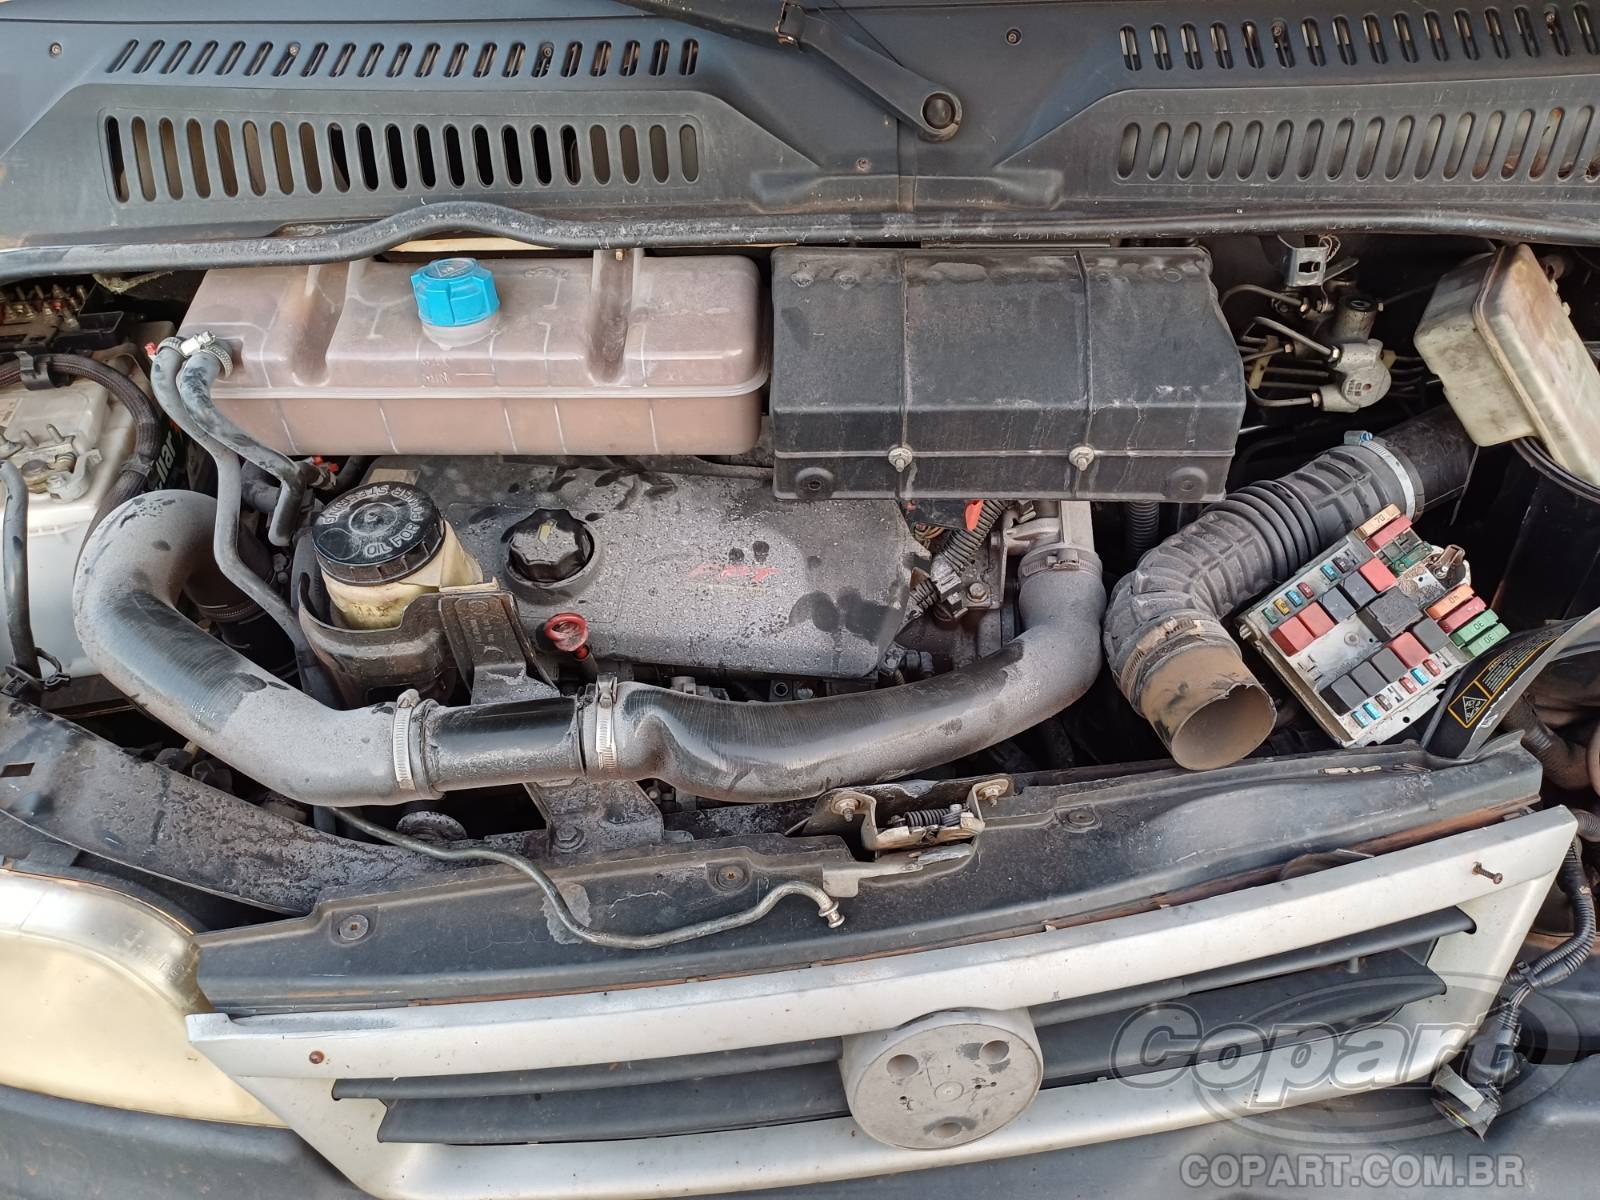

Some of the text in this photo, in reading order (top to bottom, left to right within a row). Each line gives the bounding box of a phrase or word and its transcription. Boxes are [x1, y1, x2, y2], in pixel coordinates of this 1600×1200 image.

[322, 484, 389, 525] STEERING
[390, 522, 420, 548] FOR
[364, 541, 392, 558] OIL
